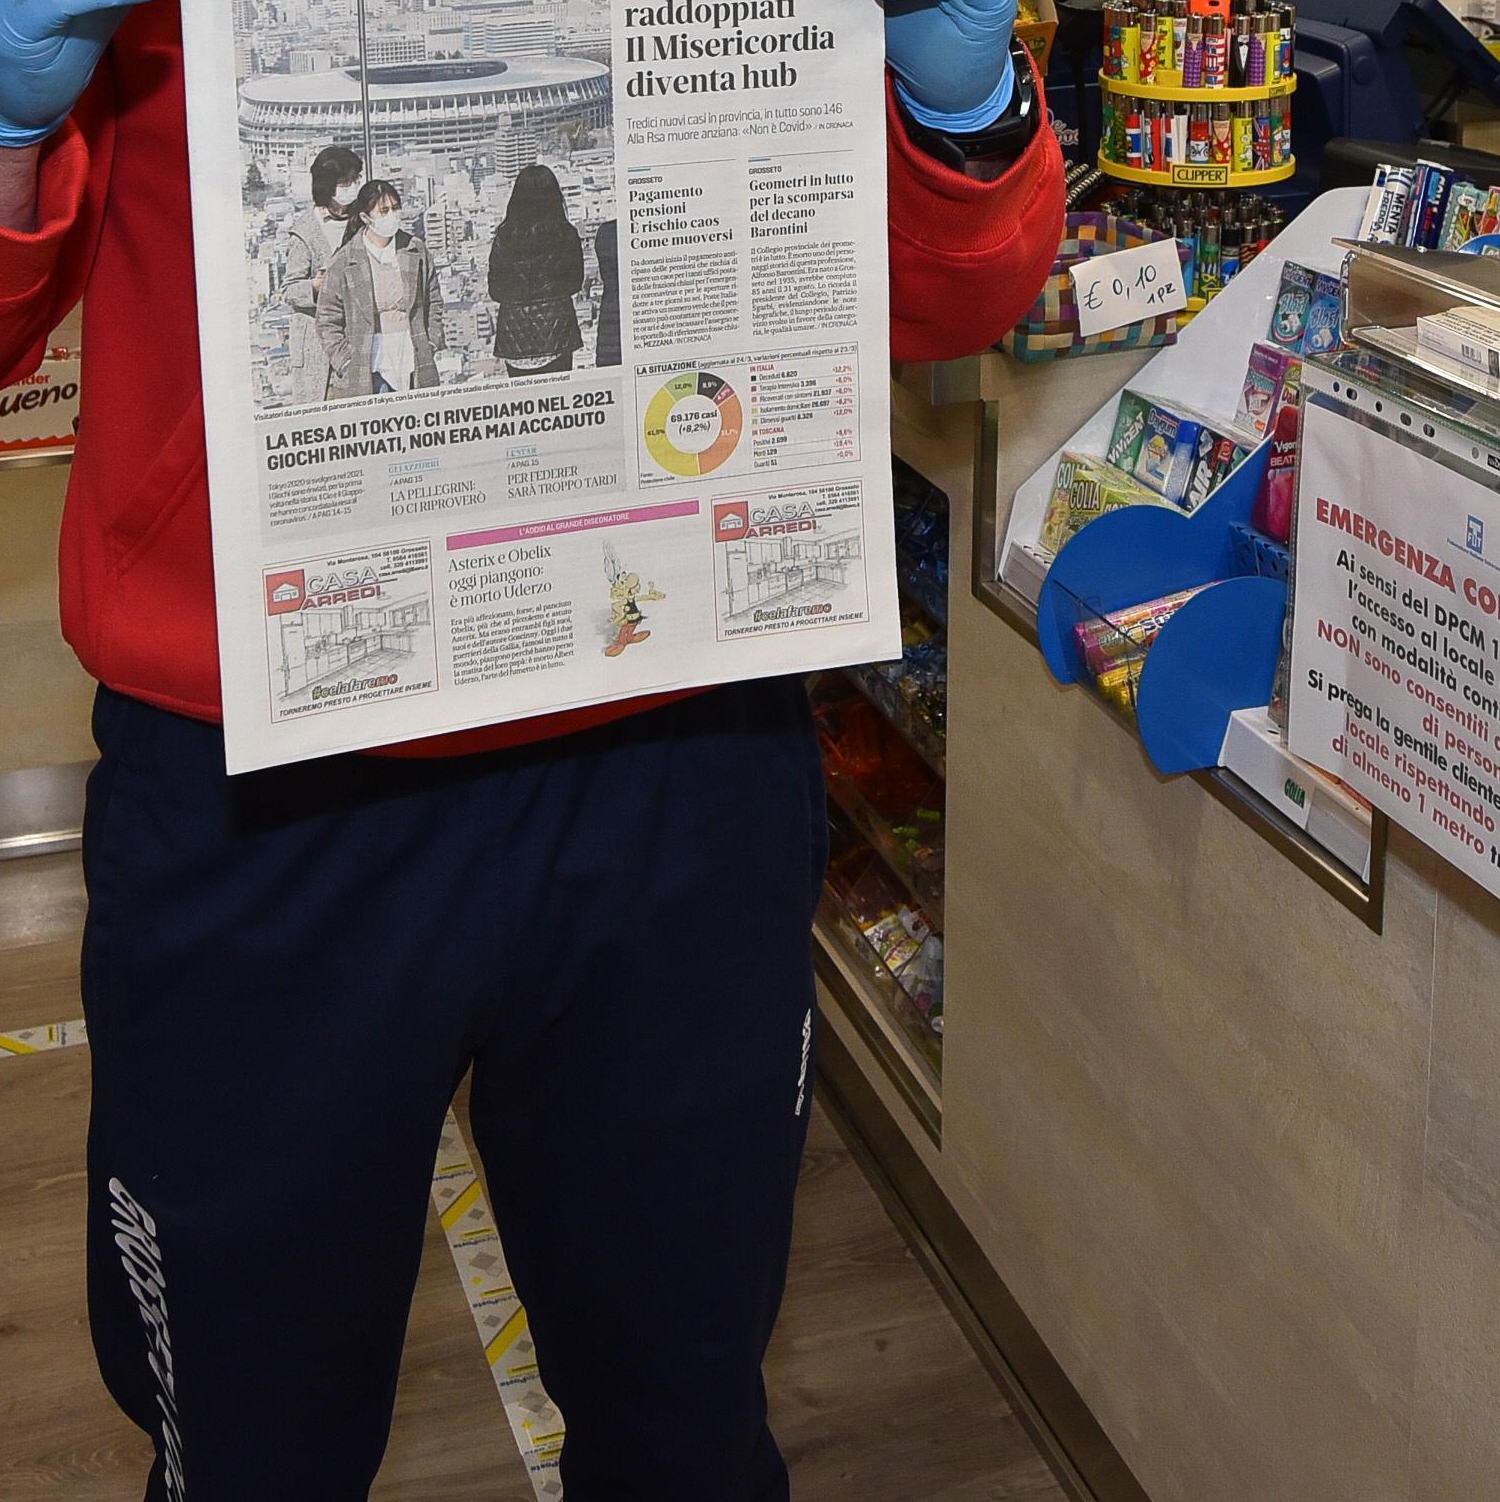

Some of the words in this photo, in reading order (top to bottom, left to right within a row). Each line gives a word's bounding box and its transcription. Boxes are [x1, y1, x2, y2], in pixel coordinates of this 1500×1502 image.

[626, 36, 645, 62] Il
[653, 25, 835, 61] Misericordia
[626, 70, 735, 98] diventa
[742, 61, 797, 90] hub
[1177, 167, 1226, 184] CLIPPER
[1384, 193, 1406, 234] MENTA
[266, 434, 288, 450] LA
[292, 426, 337, 447] RESA
[340, 423, 357, 439] DI
[360, 415, 421, 436] TOKYO:
[425, 412, 440, 427] CI
[444, 400, 534, 426] RIVEDIAMO
[539, 396, 570, 413] NEL
[573, 390, 615, 409] 2021
[267, 448, 325, 470] GIOCHI
[329, 437, 406, 461] RINVIATI,
[410, 432, 446, 450] NON
[450, 428, 482, 444] ERA
[486, 422, 515, 439] MAI
[518, 411, 605, 435] ACCADUTO
[448, 555, 495, 572] Asterix
[498, 553, 505, 564] e
[508, 546, 552, 563] Obelix
[1316, 498, 1457, 594] EMERGENZA
[449, 573, 477, 592] oggi
[480, 566, 544, 588] piangono:
[450, 595, 458, 608] è
[461, 590, 501, 607] morto
[504, 582, 552, 598] Uderzo
[1336, 550, 1355, 573] Ai
[1359, 564, 1397, 600] sensi
[1402, 588, 1428, 618] del
[1435, 604, 1485, 652] DPCM
[1492, 639, 1498, 660] 1
[1348, 579, 1415, 638] l'accesso
[1421, 630, 1437, 651] al
[1443, 637, 1495, 686] locale
[1352, 615, 1376, 642] con
[1381, 634, 1457, 691] modalità
[1317, 619, 1361, 658] NON
[1364, 651, 1401, 685] sono
[1407, 678, 1489, 742] consentiti
[1308, 669, 1323, 692] Si
[1327, 683, 1373, 721] prega
[1376, 707, 1390, 733] la
[1394, 726, 1448, 772] gentile
[1422, 714, 1439, 738] di
[1332, 735, 1348, 757] di
[1352, 751, 1412, 803] almeno
[1419, 793, 1425, 813] 1
[1432, 807, 1485, 855] metro
[1346, 712, 1390, 761] locale
[1395, 753, 1495, 832] rispettando
